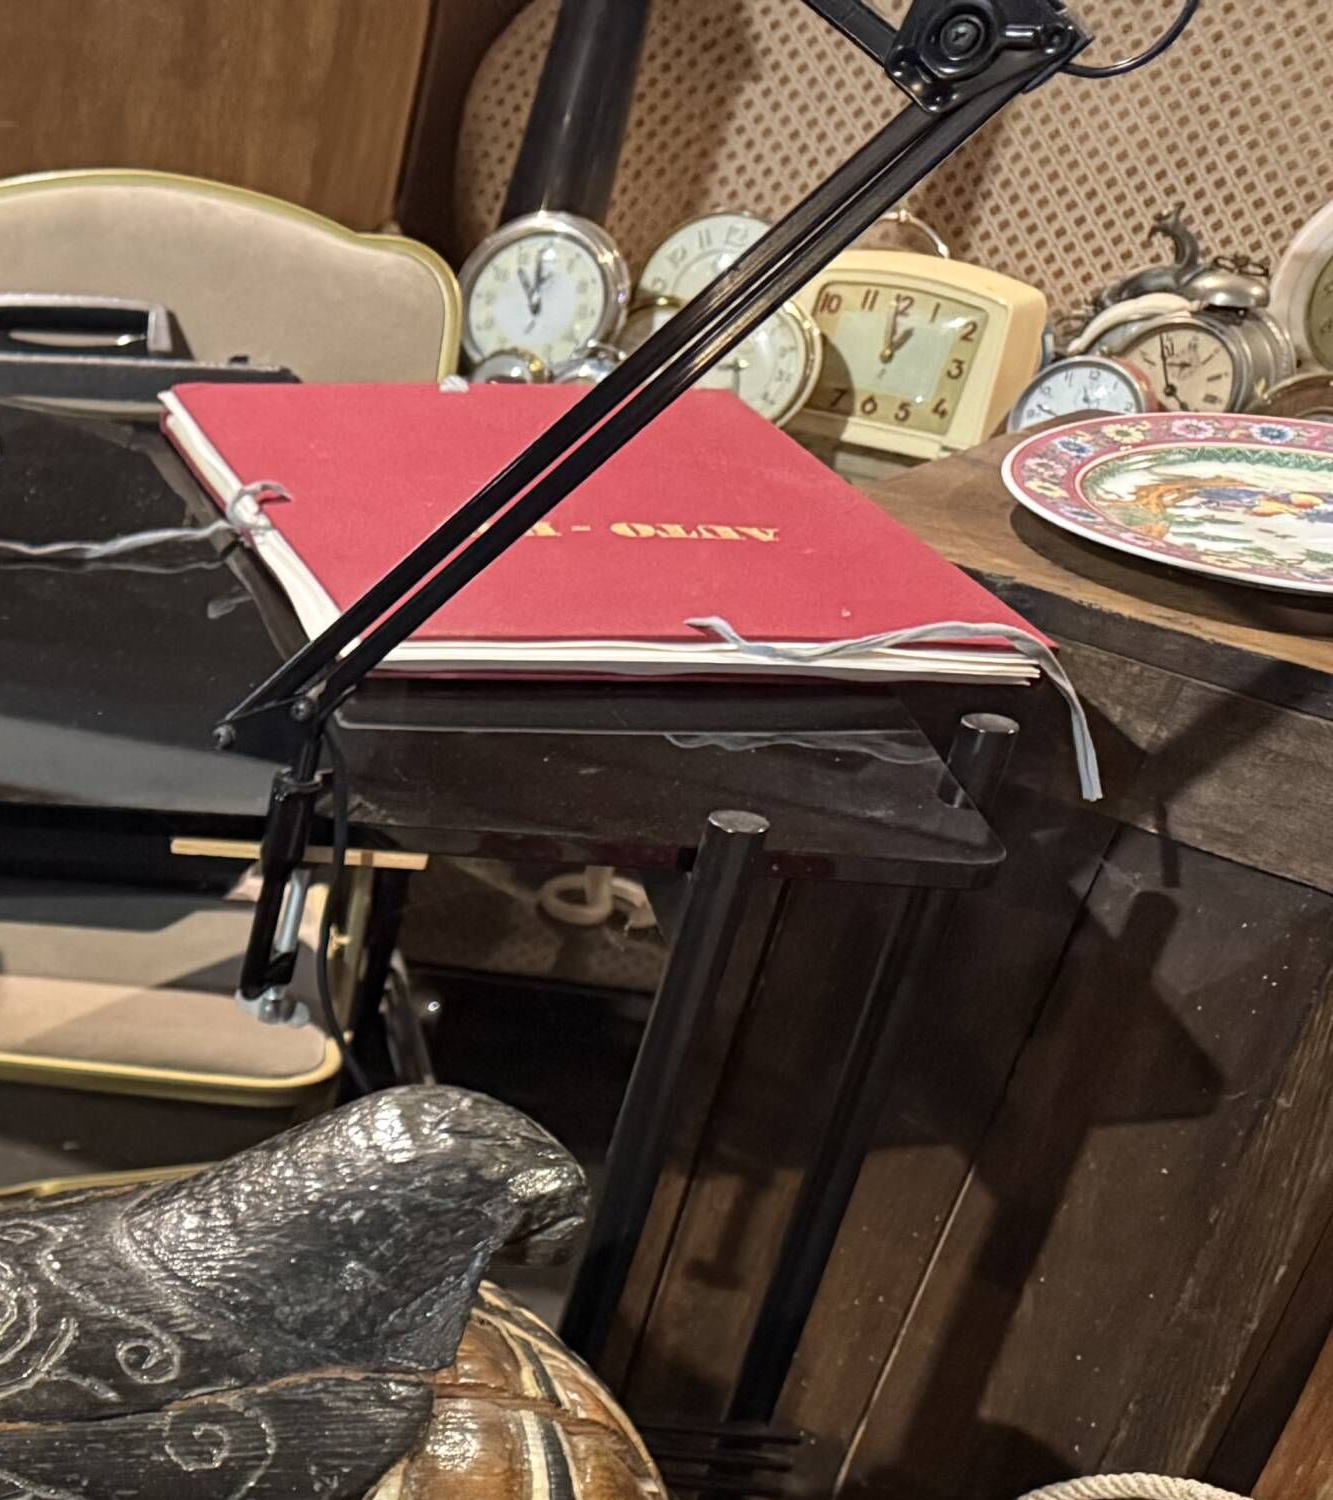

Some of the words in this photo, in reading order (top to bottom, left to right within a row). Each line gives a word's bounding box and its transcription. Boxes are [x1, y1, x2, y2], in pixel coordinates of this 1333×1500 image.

[820, 291, 843, 314] 10
[861, 289, 880, 311] 11
[895, 294, 915, 317] 12
[929, 302, 941, 324] 1
[959, 320, 978, 343] 2
[946, 358, 966, 380] 3
[829, 387, 847, 407] 7
[861, 394, 878, 415] 6
[931, 397, 949, 419] 4
[894, 401, 912, 422] 5
[610, 521, 780, 542] AUTO
